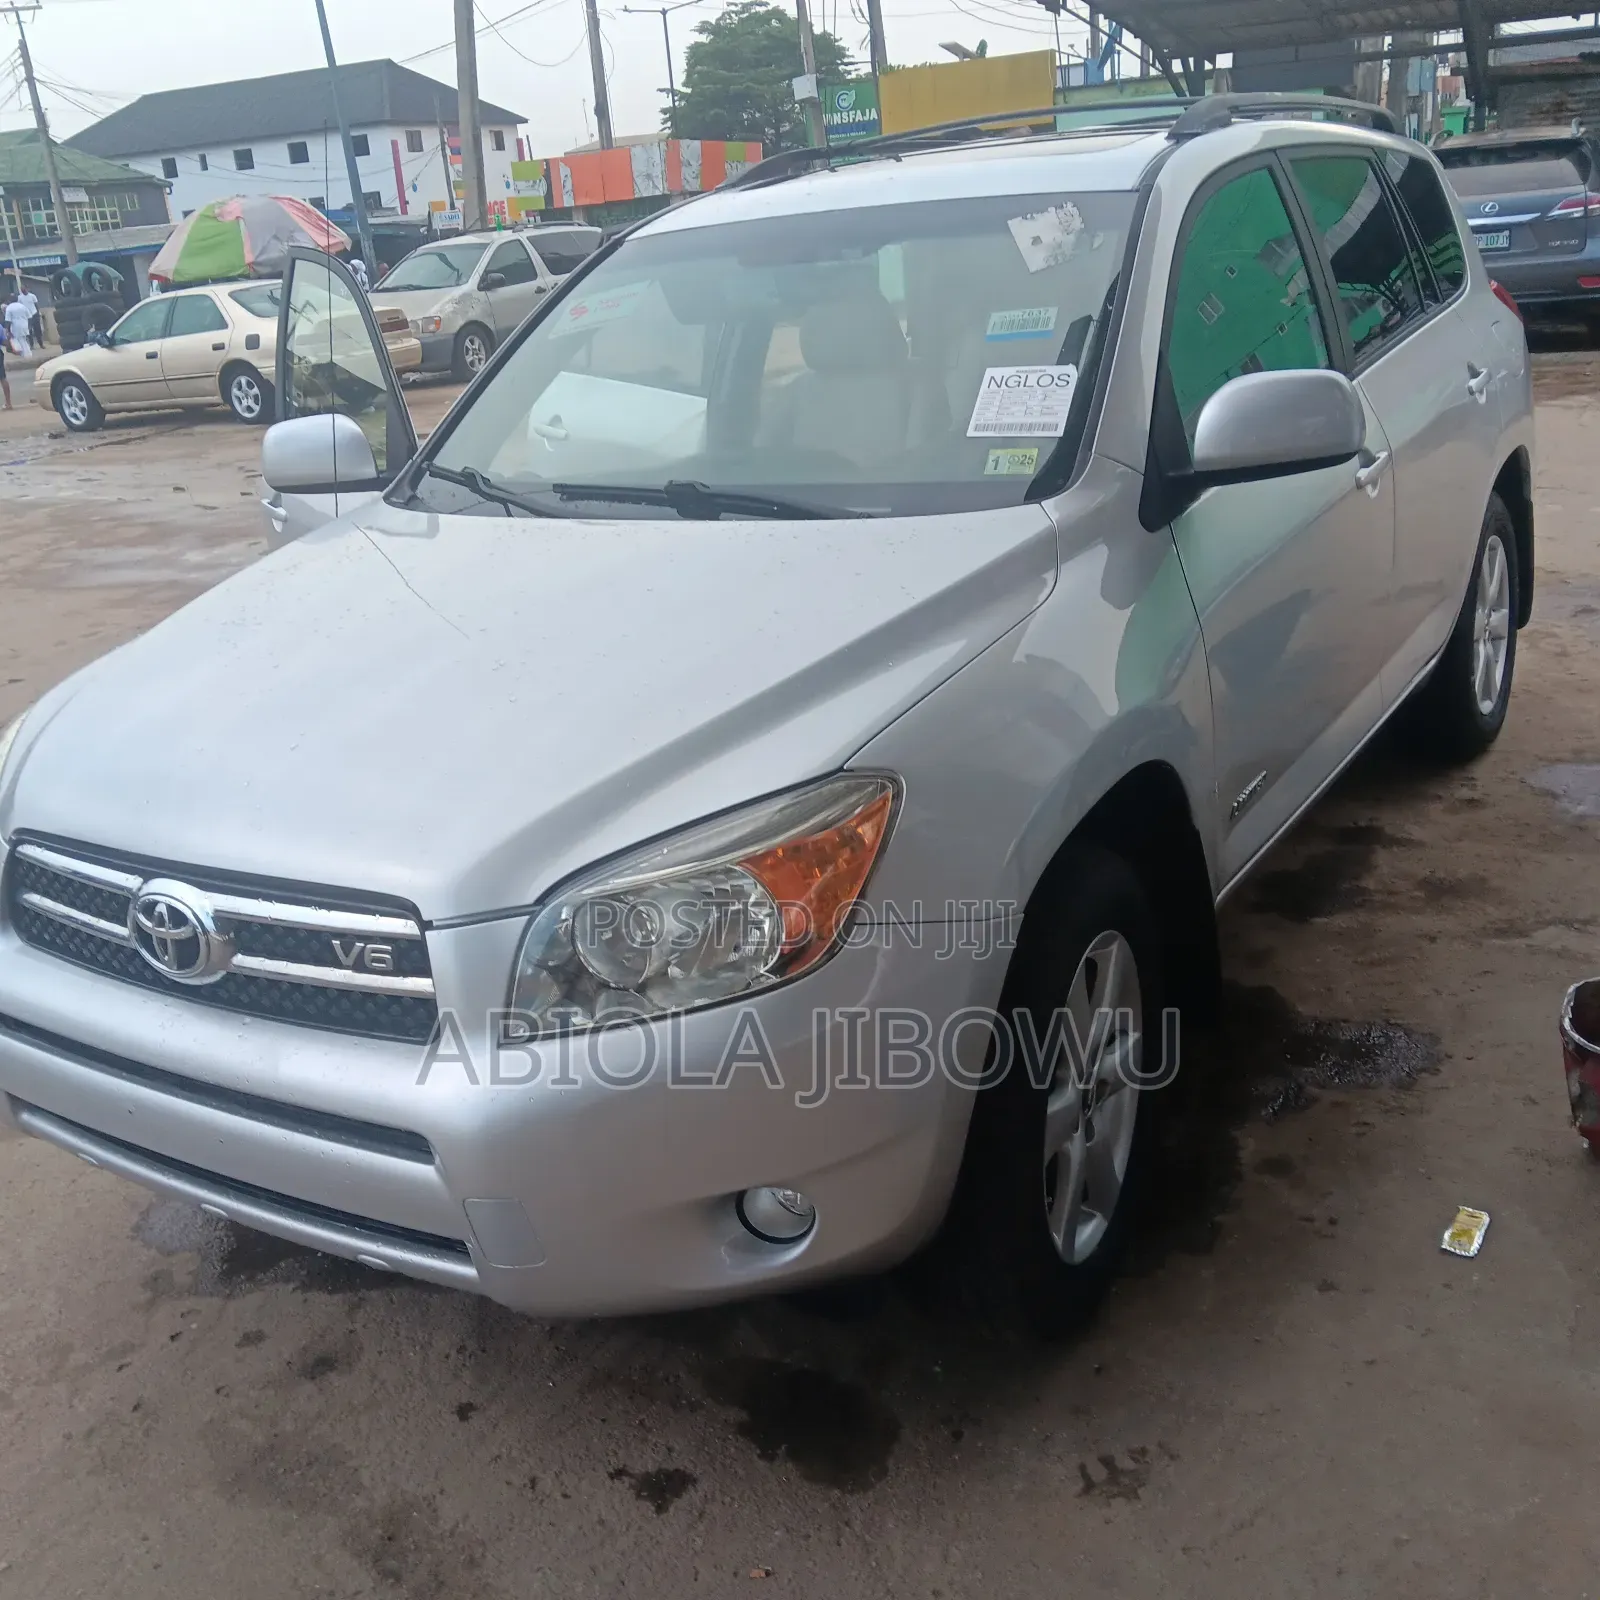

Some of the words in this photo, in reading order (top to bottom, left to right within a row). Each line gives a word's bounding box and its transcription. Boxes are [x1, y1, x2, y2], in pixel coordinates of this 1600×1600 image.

[987, 373, 1071, 389] NGLOS
[1019, 454, 1034, 465] 25
[331, 939, 394, 971] V6
